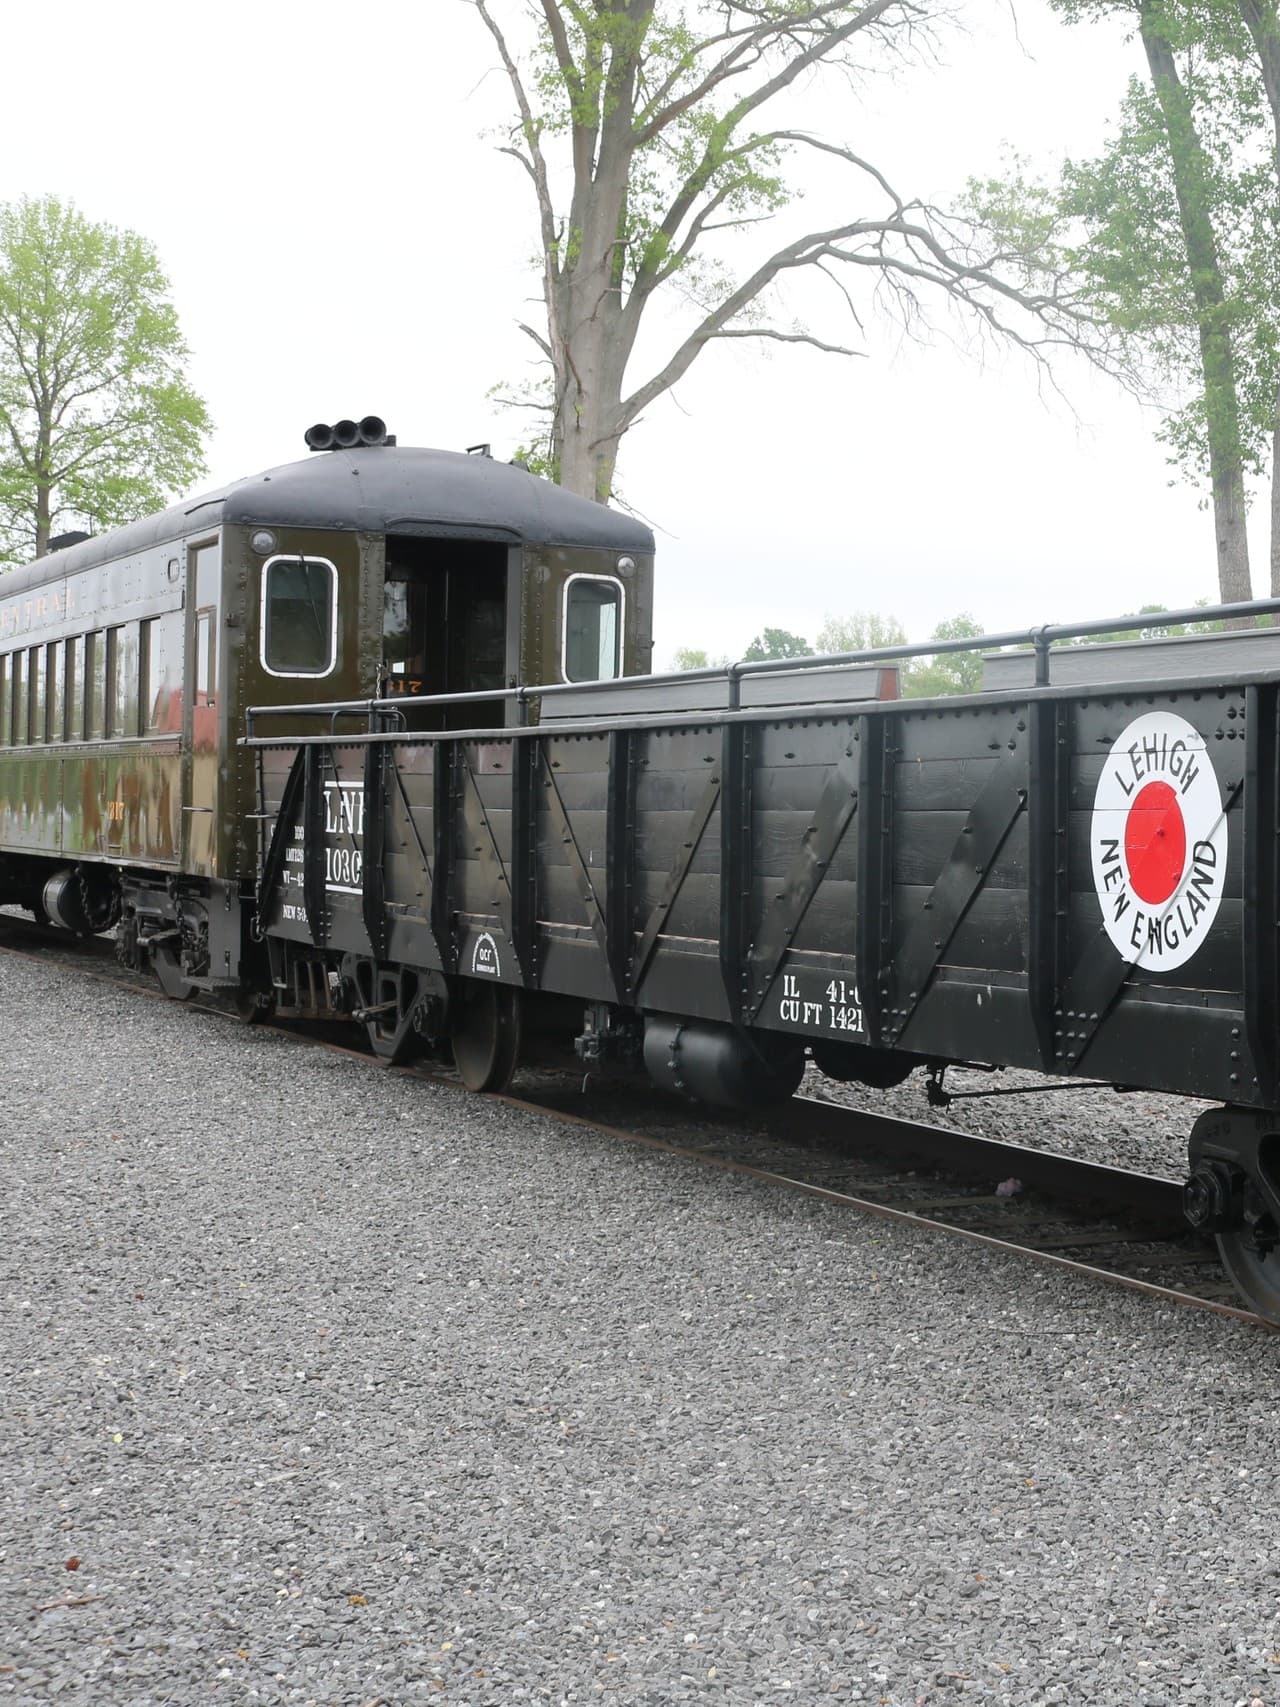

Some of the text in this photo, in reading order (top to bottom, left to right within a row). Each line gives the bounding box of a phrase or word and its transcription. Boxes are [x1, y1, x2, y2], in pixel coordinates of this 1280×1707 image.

[1115, 733, 1200, 796] LEHIGH
[1100, 839, 1217, 956] NEW ENGLAND
[783, 975, 800, 998] IL
[780, 1000, 864, 1033] CU FT 1421
